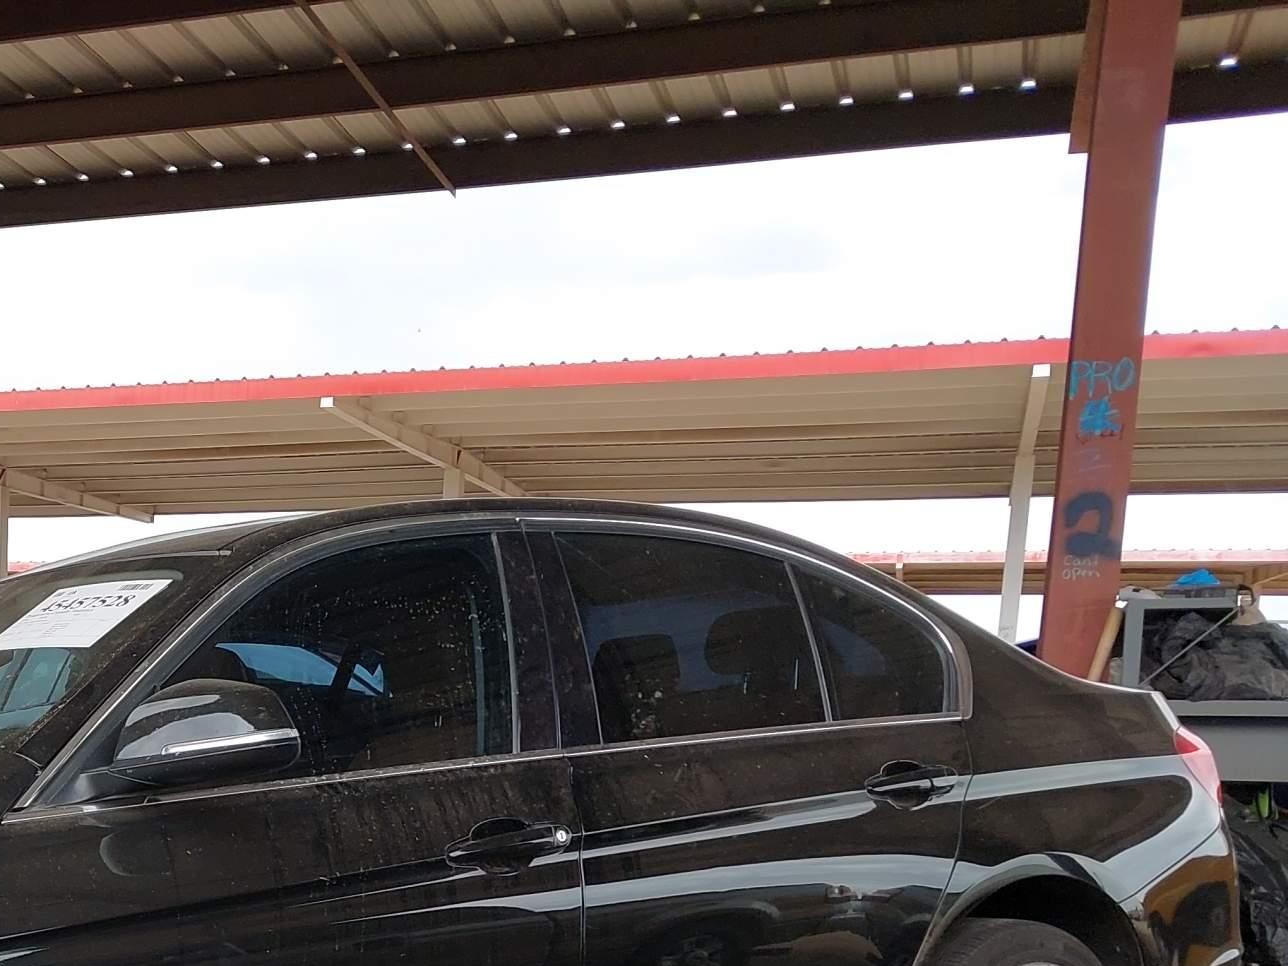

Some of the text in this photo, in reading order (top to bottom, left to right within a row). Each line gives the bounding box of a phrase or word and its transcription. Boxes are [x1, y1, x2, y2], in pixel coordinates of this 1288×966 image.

[1068, 356, 1136, 401] PRO
[1064, 491, 1121, 561] 2
[41, 594, 136, 613] 45457528
